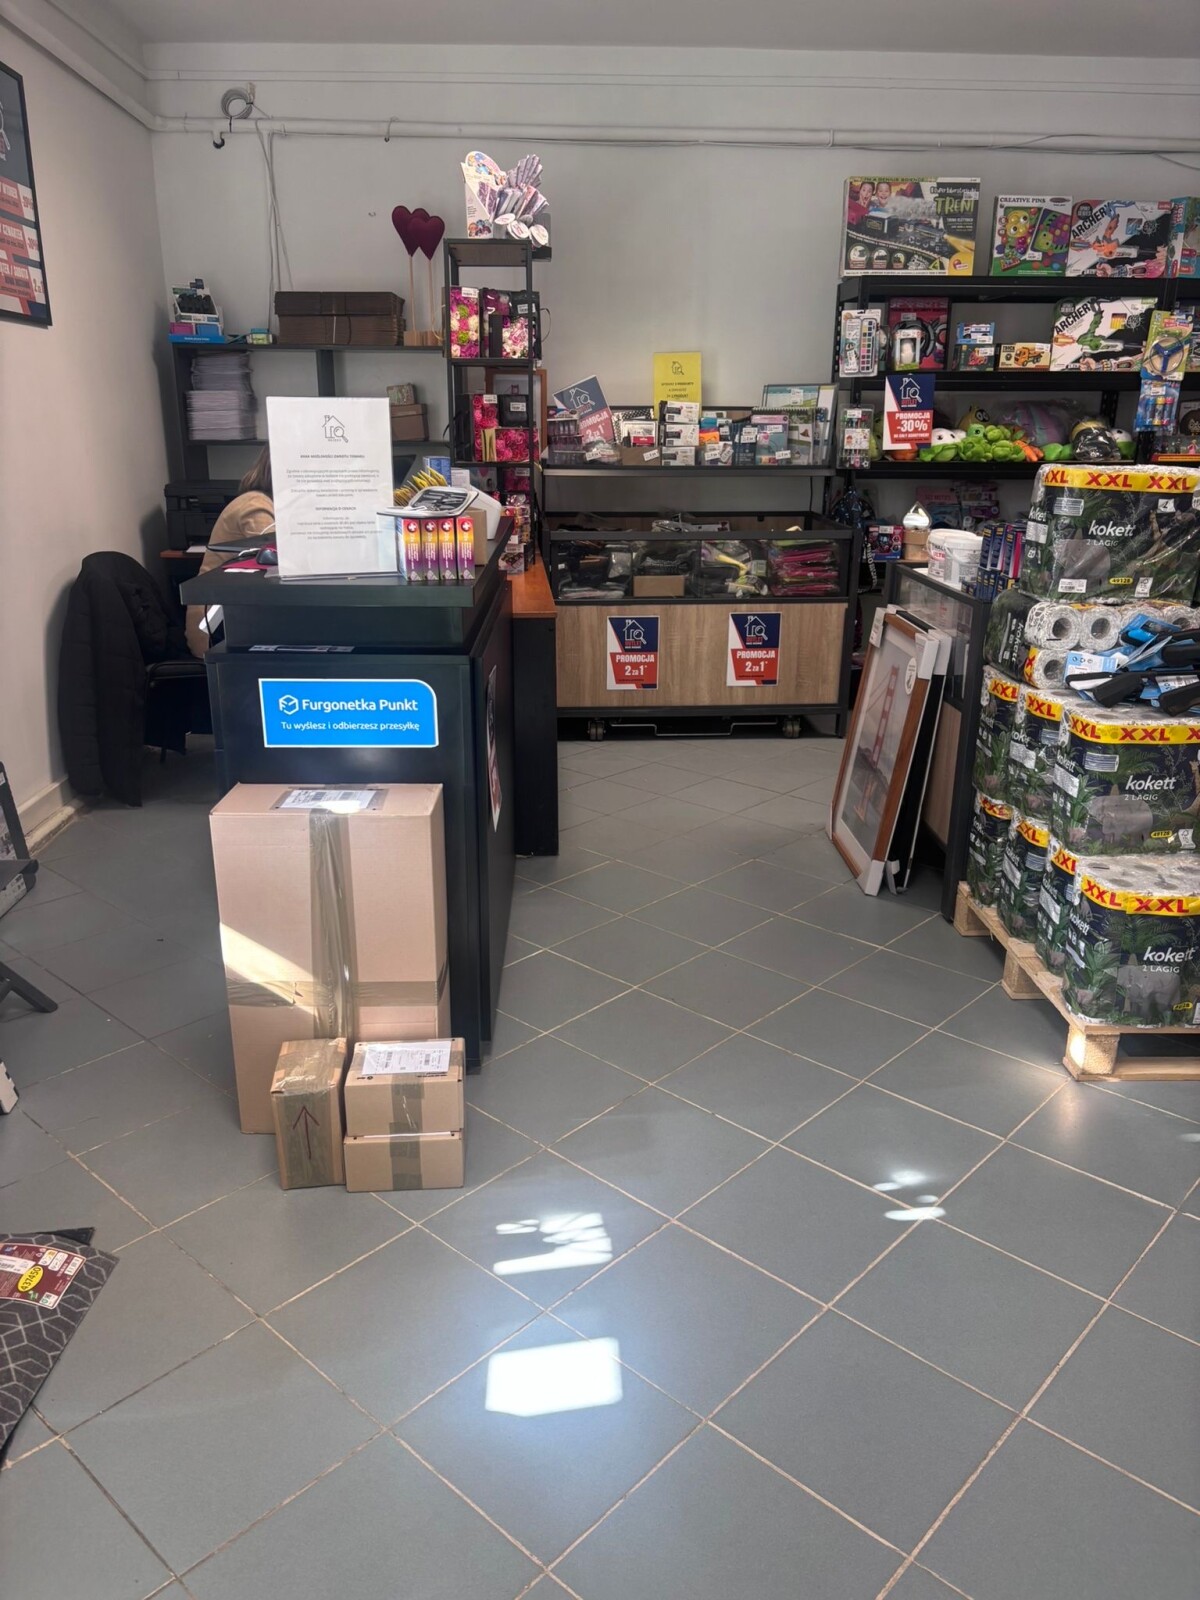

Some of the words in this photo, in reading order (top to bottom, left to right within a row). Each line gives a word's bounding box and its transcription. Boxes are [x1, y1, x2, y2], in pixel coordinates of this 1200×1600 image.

[895, 412, 931, 420] PROMOCJA
[1085, 472, 1133, 488] XXL
[1146, 475, 1191, 491] XXL
[616, 654, 655, 663] PROMOCJA
[736, 650, 776, 659] PROMOCJA
[625, 665, 631, 676] 2
[745, 661, 752, 672] 2
[991, 680, 1018, 699] XXL
[302, 699, 377, 713] Furgonetka
[379, 698, 419, 711] Punkt
[1027, 696, 1057, 718] XXL
[281, 722, 292, 730] Tu
[293, 721, 326, 731] wyślesz
[332, 721, 379, 731] odbierzesz
[380, 721, 420, 732] przesyłkę
[1071, 715, 1101, 740] XXL
[1119, 727, 1170, 742] XXL
[1125, 774, 1177, 791] kokett
[1084, 879, 1122, 907] XXL
[1133, 898, 1190, 914] XXL
[1143, 946, 1195, 963] kokett
[1150, 966, 1180, 974] LAGIG
[20, 1267, 42, 1290] 437450
